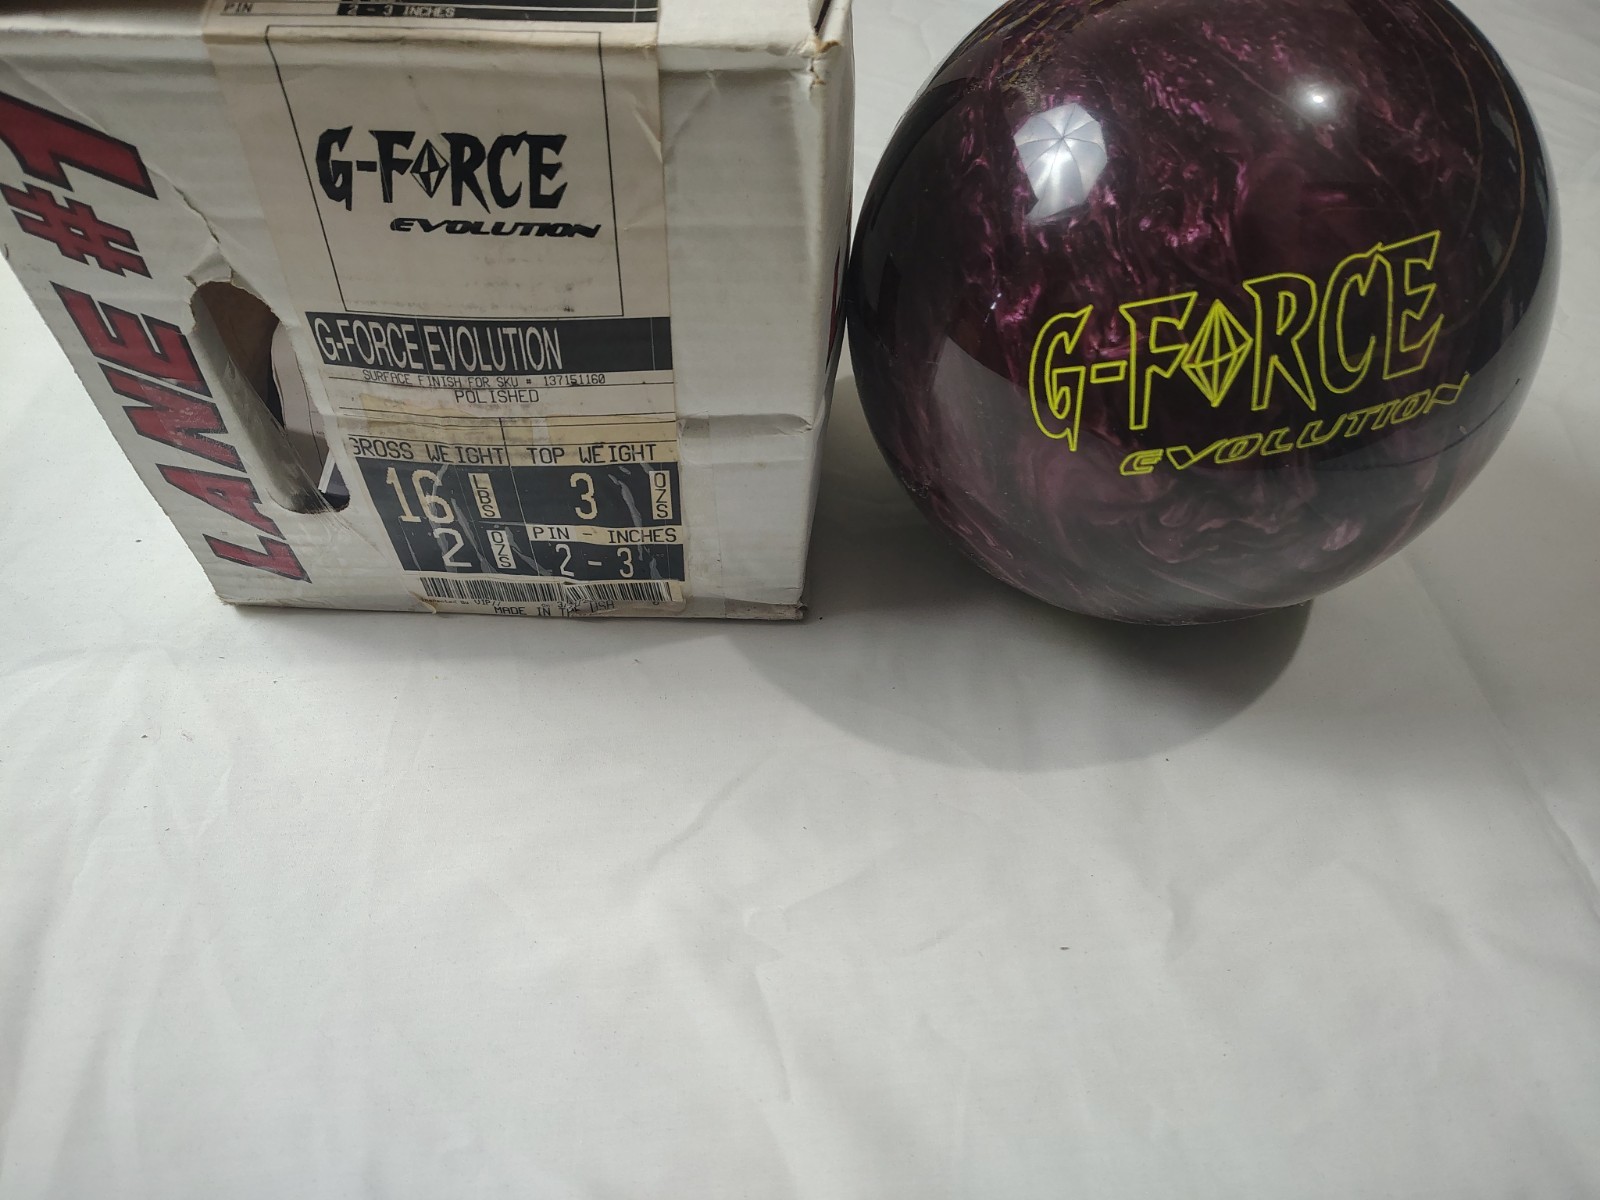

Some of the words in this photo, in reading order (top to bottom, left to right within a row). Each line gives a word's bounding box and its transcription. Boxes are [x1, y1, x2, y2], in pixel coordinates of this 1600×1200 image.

[222, 2, 254, 13] PIN
[347, 4, 358, 16] 2
[382, 4, 394, 16] 3
[403, 5, 456, 18] INCHES
[390, 217, 601, 238] EVOLUTION
[314, 317, 425, 370] G-FORCE
[424, 324, 563, 372] EVOLUTION
[362, 369, 413, 386] SURFACE
[419, 376, 462, 388] FINISH
[469, 378, 491, 388] FOR
[497, 377, 519, 389] SKU
[543, 374, 606, 387] 137151160
[455, 389, 540, 404] POLISHED
[50, 281, 312, 584] LANE
[1120, 371, 1470, 476] EVOLUTION
[425, 443, 506, 465] WEIGHT
[526, 447, 565, 465] TOP
[579, 443, 657, 465] WEIGHT
[386, 466, 455, 524] 16
[470, 473, 496, 518] LBS
[570, 472, 598, 520] 3
[533, 527, 570, 540] PIN
[608, 528, 677, 544] INCHES
[433, 528, 472, 567] 2
[555, 544, 574, 577] 2
[617, 547, 634, 578] 3
[494, 606, 526, 616] MADE
[537, 606, 551, 617] IN
